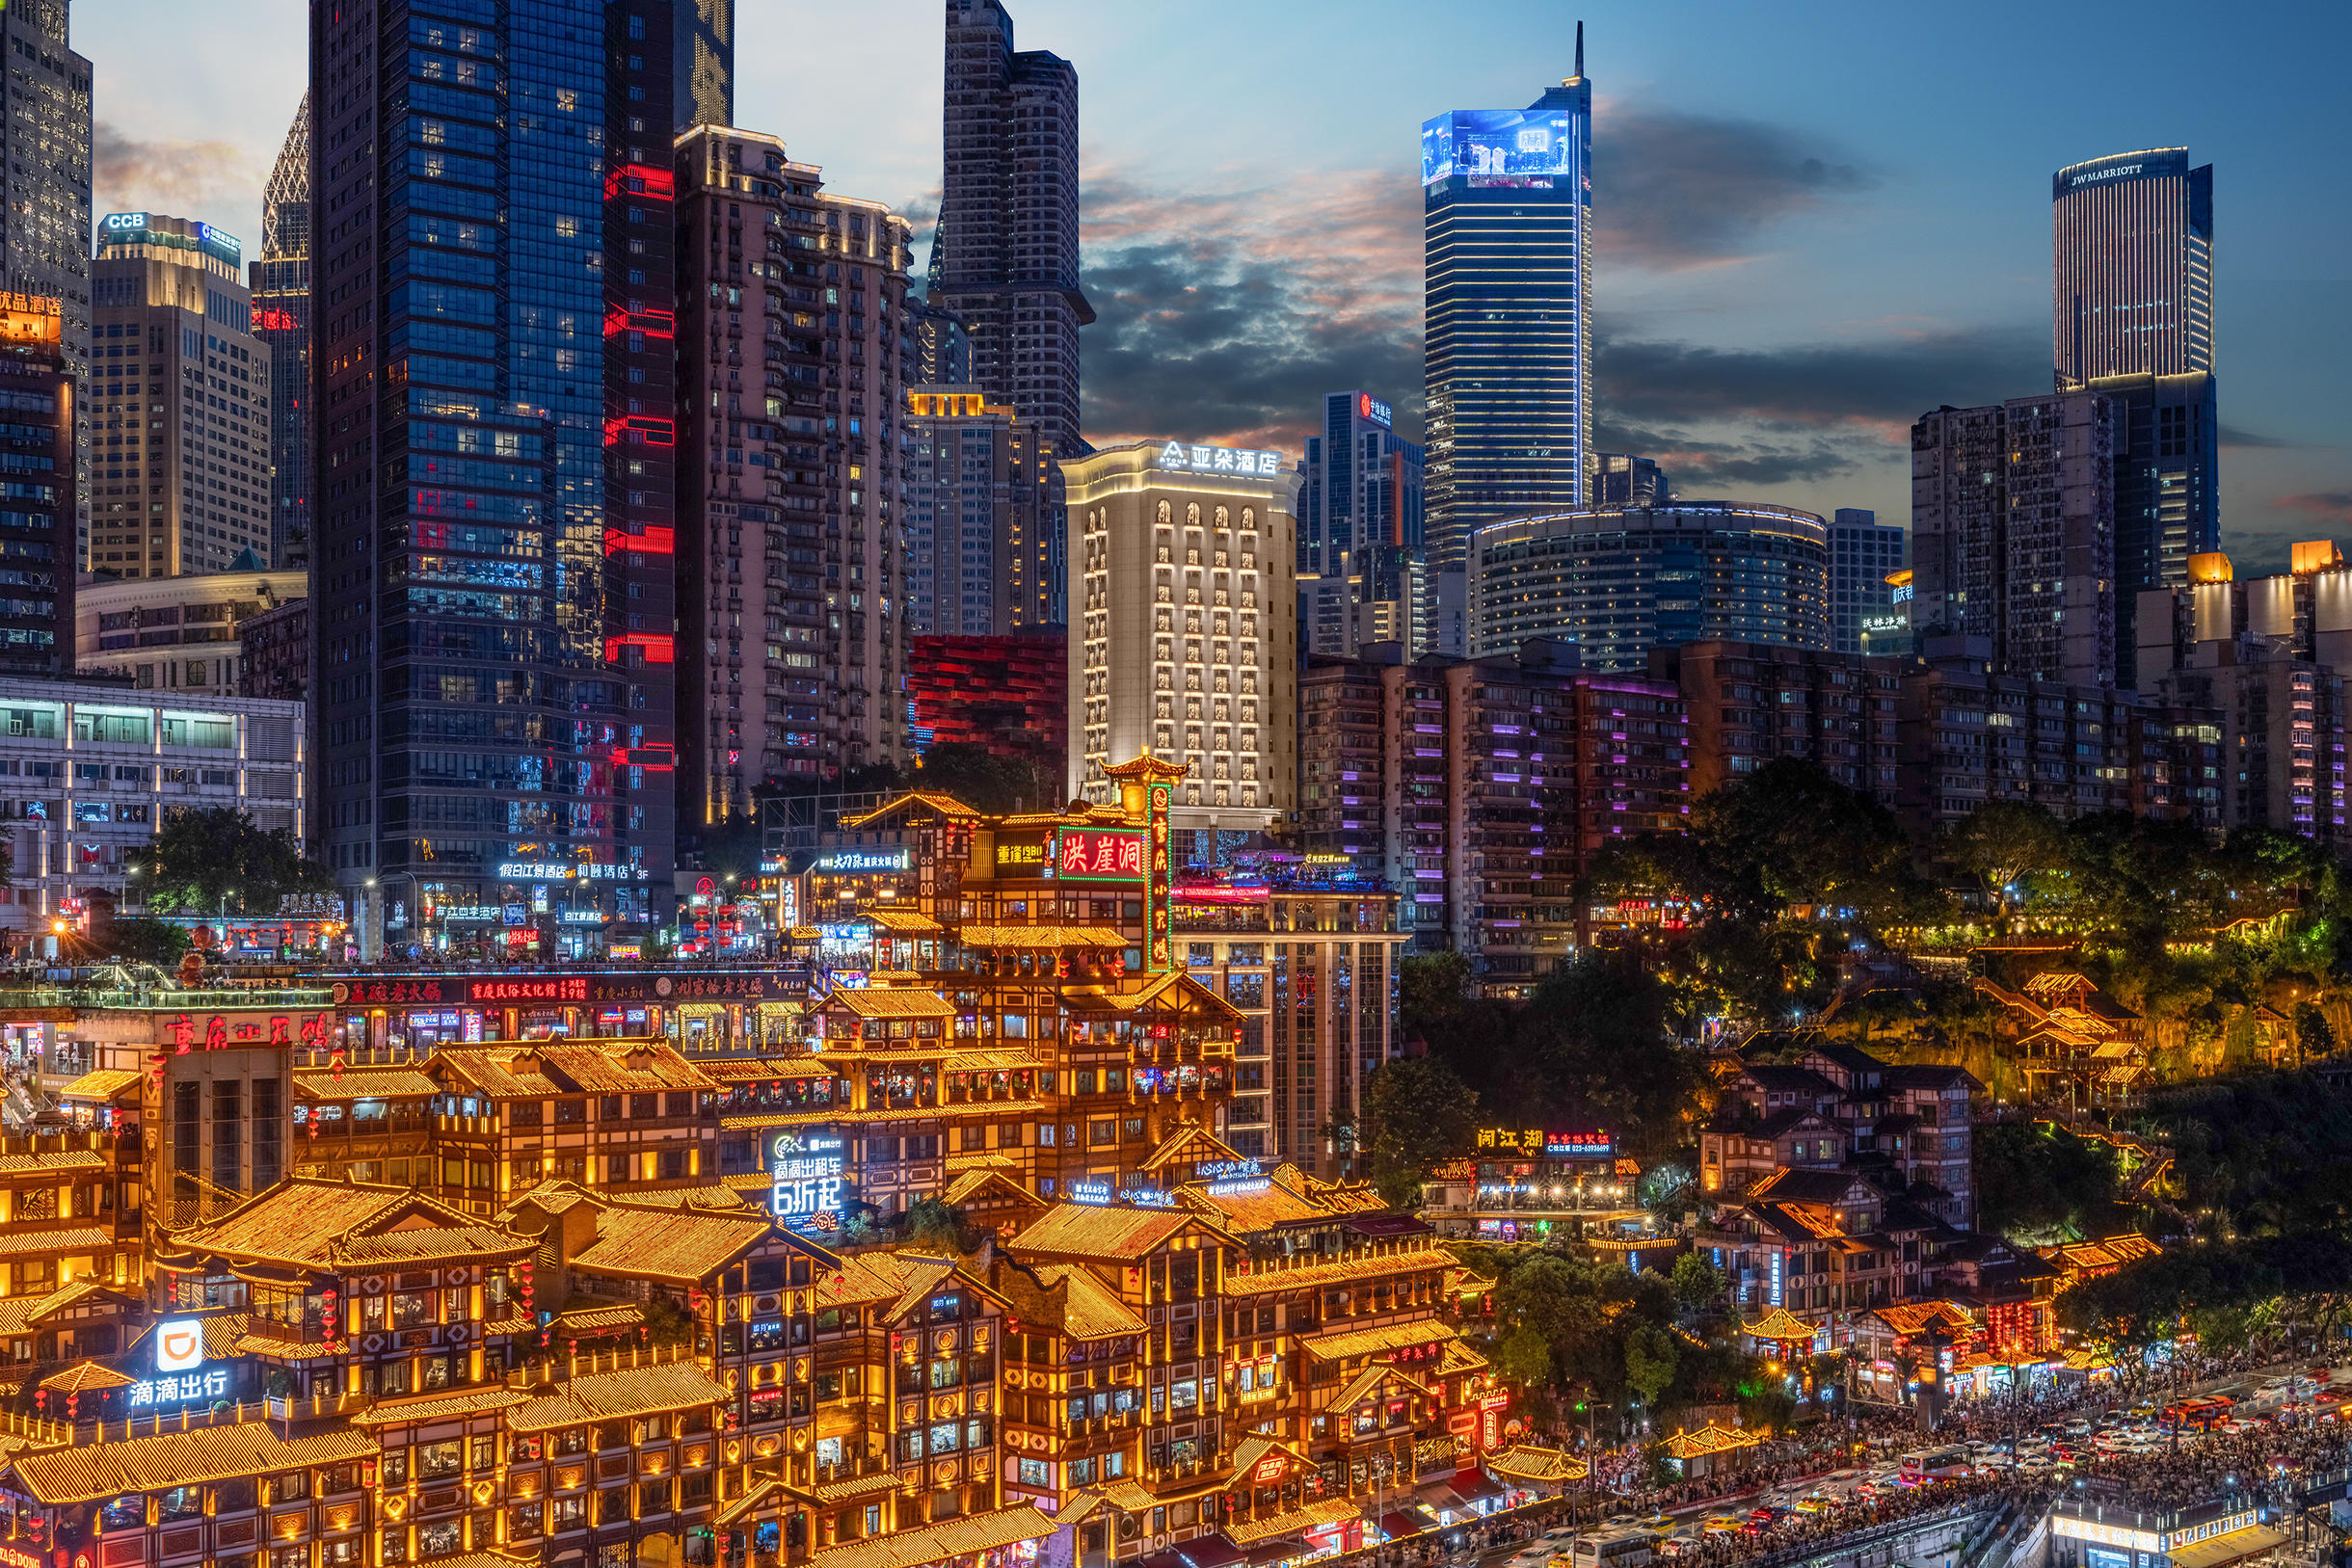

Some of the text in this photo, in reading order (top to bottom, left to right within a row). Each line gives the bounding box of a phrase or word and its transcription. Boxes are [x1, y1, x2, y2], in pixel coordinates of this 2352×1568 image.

[2072, 164, 2142, 186] JW MARRIOTT
[108, 215, 144, 228] CCB
[1191, 446, 1278, 474] 亚朵酒店
[1063, 834, 1142, 874] 洪崖洞
[499, 863, 567, 879] 假日江景酒店
[576, 864, 649, 879] 和颐酒店 3F
[436, 905, 501, 917] 两江四季酒店
[166, 1013, 329, 1056] 重庆小天鹅
[1478, 1129, 1543, 1148] 闹江湖
[774, 1157, 842, 1181] 滴滴出租车
[774, 1176, 842, 1215] 6折起
[129, 1370, 227, 1406] 滴滴出行
